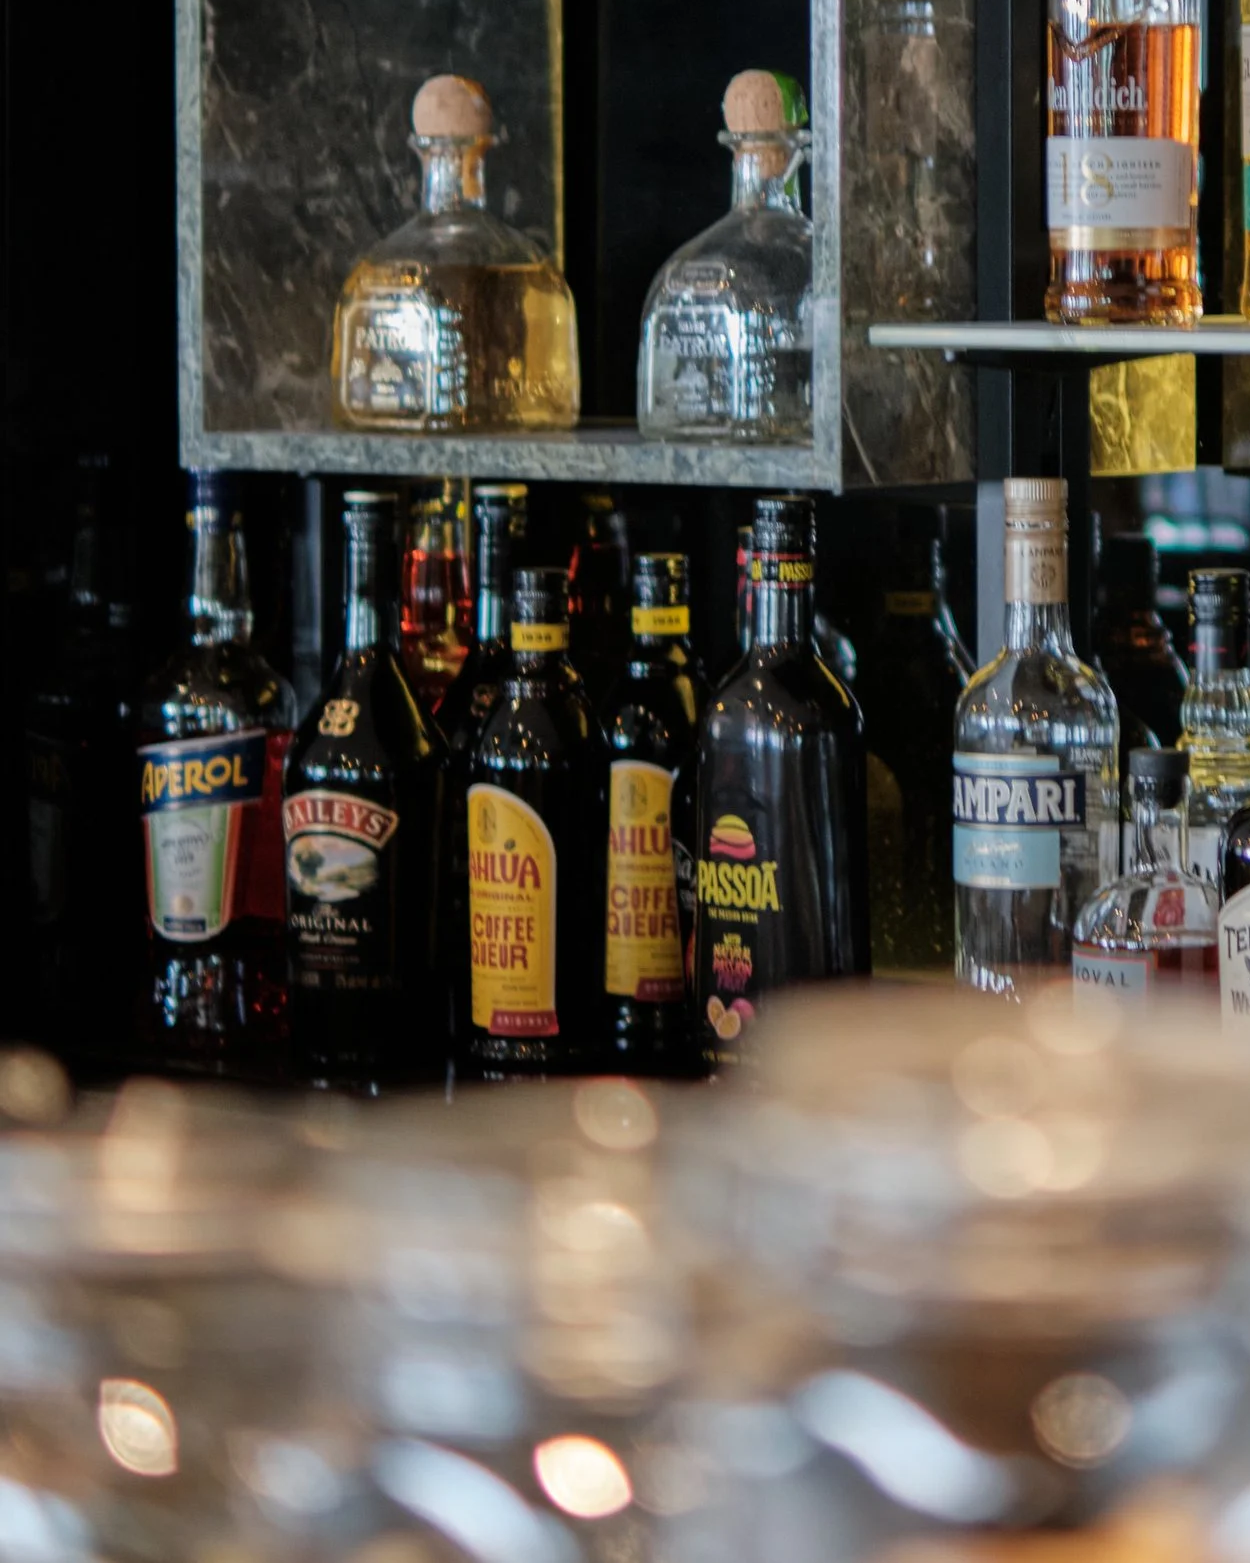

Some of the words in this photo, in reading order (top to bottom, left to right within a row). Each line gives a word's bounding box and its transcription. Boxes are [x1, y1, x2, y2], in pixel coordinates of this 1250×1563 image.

[1060, 149, 1116, 207] 18
[140, 753, 249, 806] APEROL
[285, 799, 386, 837] BAILEYS
[290, 915, 373, 934] ORIGINAL
[473, 910, 535, 944] COFFEE
